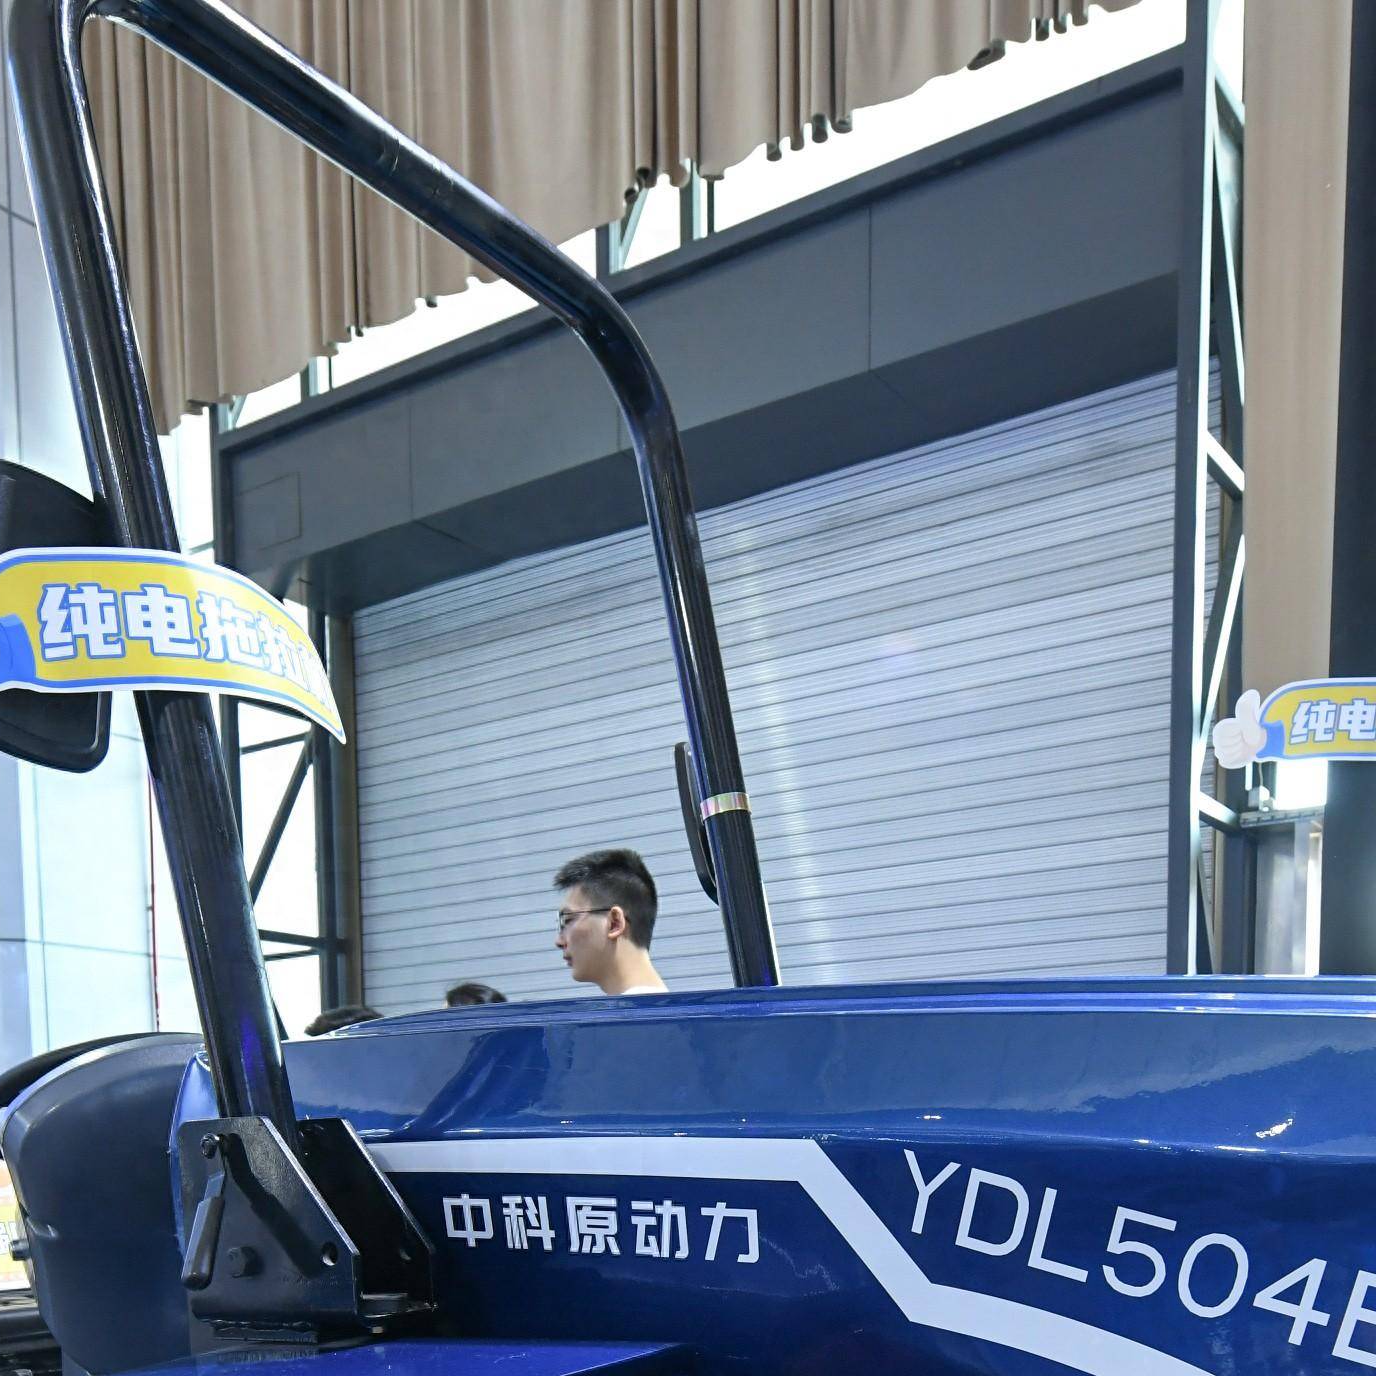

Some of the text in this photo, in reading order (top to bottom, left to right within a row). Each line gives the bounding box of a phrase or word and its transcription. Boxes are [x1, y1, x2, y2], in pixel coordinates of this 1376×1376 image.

[442, 1193, 762, 1265] 中科原动力
